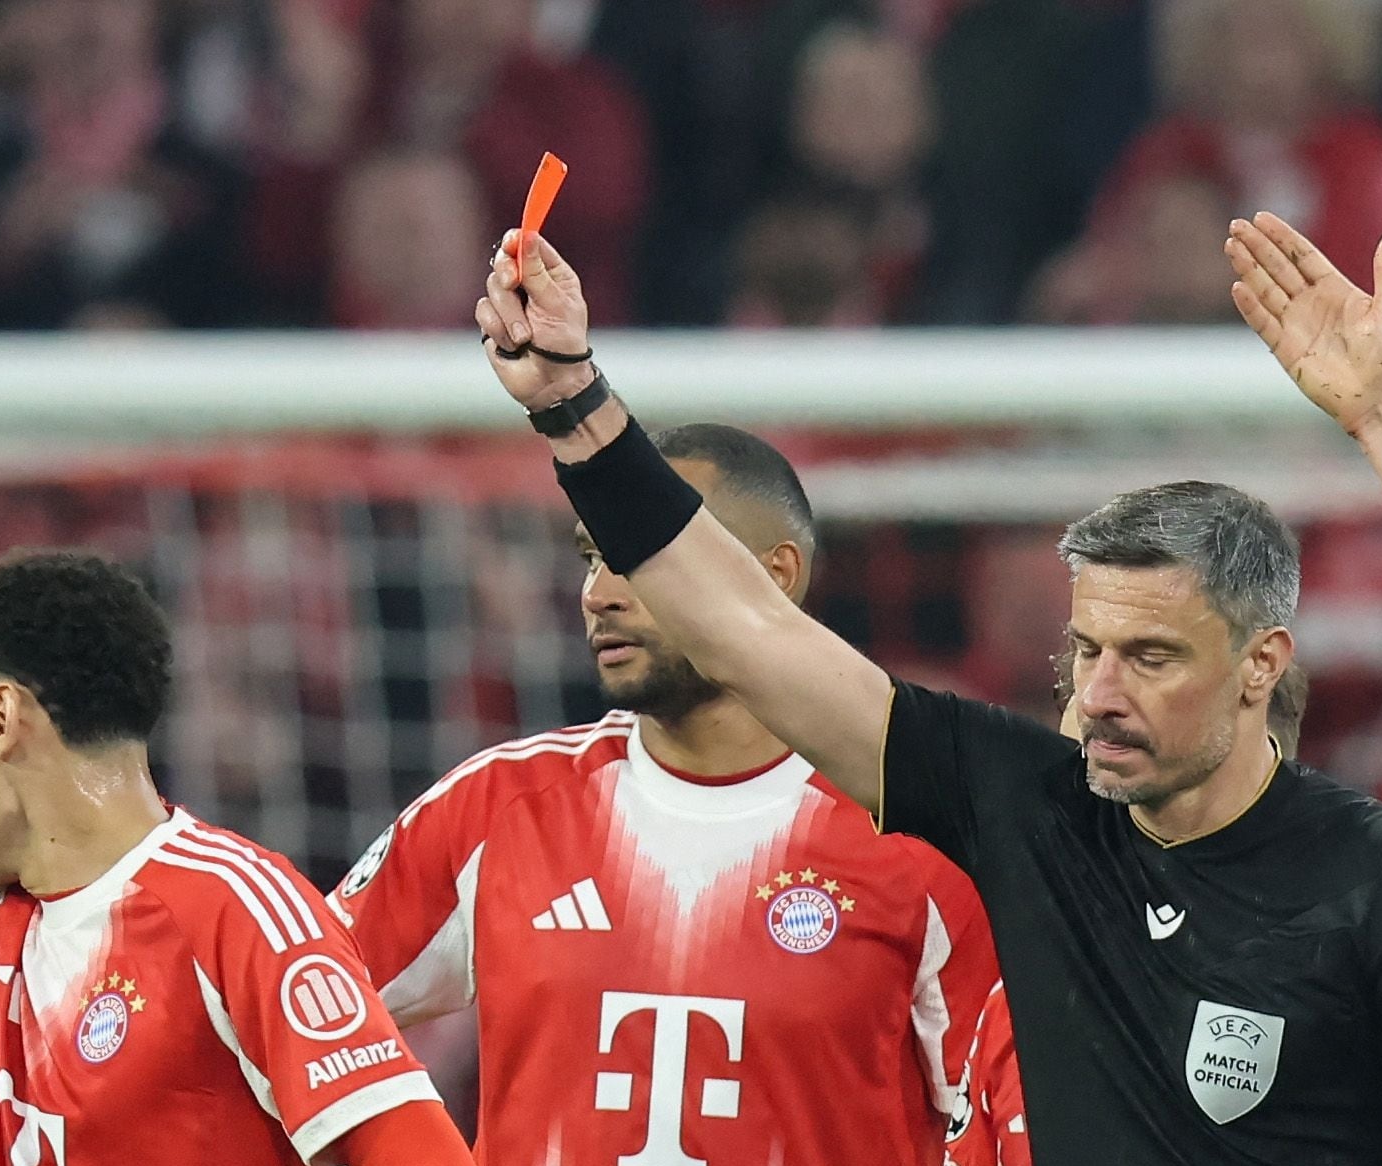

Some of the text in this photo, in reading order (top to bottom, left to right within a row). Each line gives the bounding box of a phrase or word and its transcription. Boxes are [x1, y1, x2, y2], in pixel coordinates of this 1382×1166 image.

[774, 892, 834, 920] FC BAYERN
[1209, 1019, 1262, 1046] UEFA
[304, 1038, 404, 1090] Allianz
[1203, 1052, 1258, 1074] MATCH
[1194, 1069, 1260, 1093] OFFICIAL
